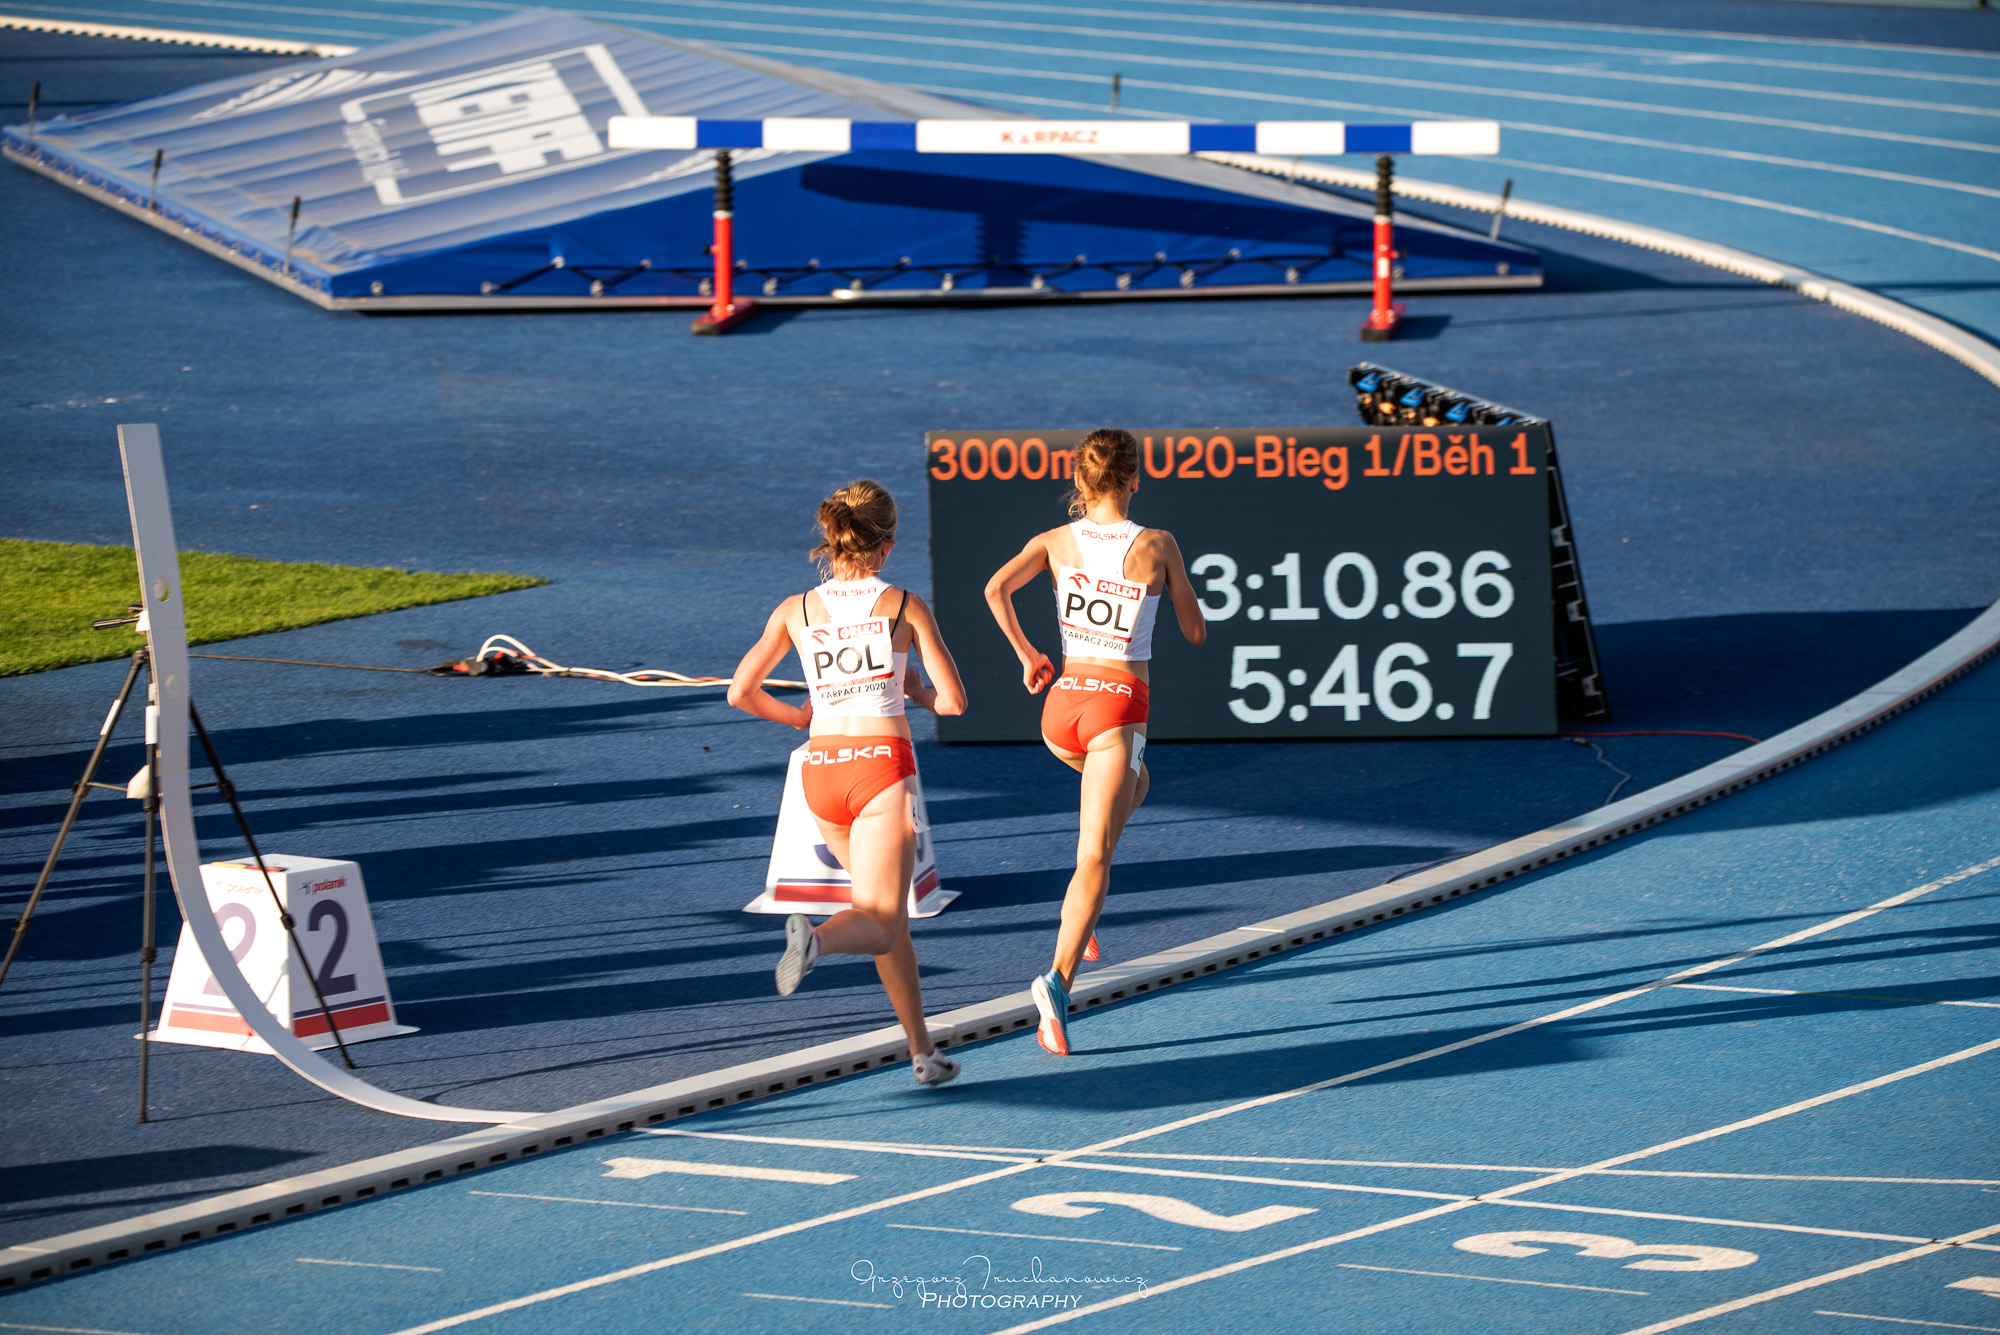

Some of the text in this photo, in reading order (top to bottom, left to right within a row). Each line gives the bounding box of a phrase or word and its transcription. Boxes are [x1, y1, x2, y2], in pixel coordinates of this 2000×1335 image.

[1001, 130, 1099, 143] KARPACZ
[1143, 436, 1349, 490] U20-Bieg
[1364, 433, 1495, 476] 1/Běh
[1509, 433, 1537, 475] 1
[1081, 529, 1128, 541] POLSKA
[826, 586, 877, 597] POLSKA
[1098, 581, 1139, 600] ORLEN
[1190, 550, 1515, 622] 3:10.86
[1065, 593, 1129, 632] POL
[839, 621, 882, 640] ORLEN
[1064, 630, 1102, 646] KARPACZ
[1103, 639, 1124, 651] 2020
[813, 643, 885, 680] POL
[820, 681, 886, 700] KARPACZ 2020
[1051, 677, 1133, 698] POLSKA
[1228, 642, 1514, 724] 5:46.7
[801, 745, 892, 766] POLSKA
[306, 899, 358, 998] 2
[600, 1156, 860, 1186] 1
[1011, 1191, 1319, 1233] 2
[1453, 1230, 1759, 1272] 3
